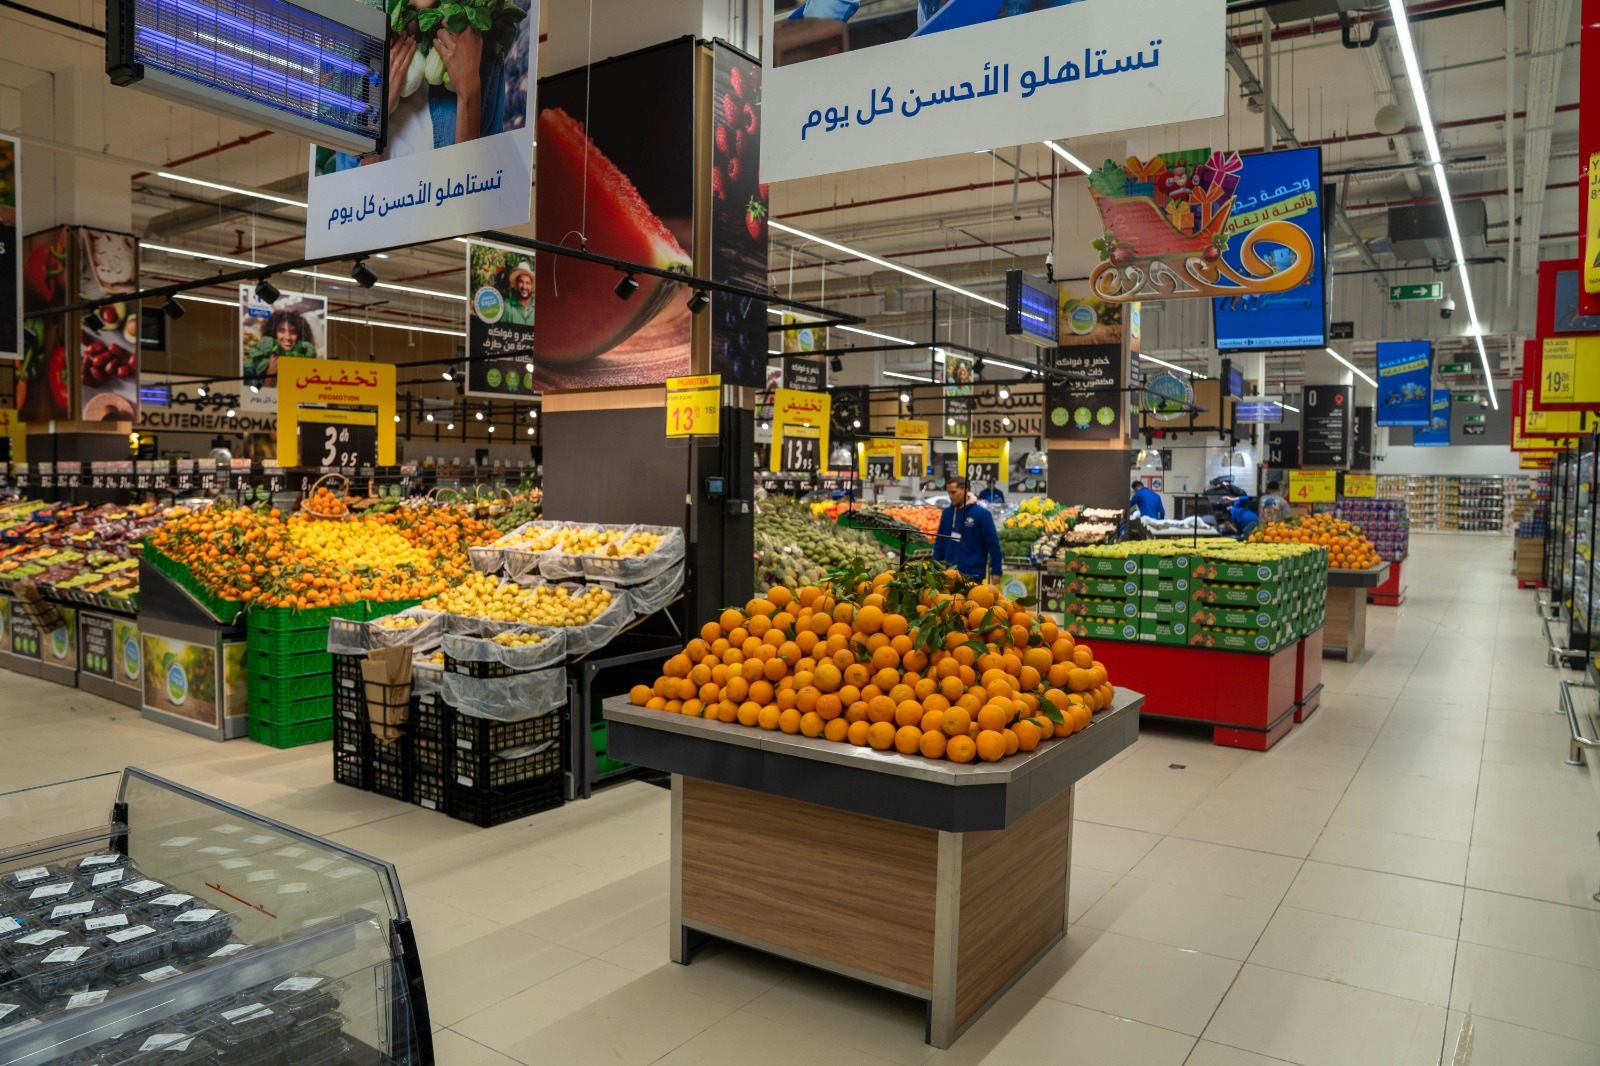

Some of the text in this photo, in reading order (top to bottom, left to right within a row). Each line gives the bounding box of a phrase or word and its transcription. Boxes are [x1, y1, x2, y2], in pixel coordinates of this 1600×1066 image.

[801, 38, 1163, 140] تستاهلو الأحسن كل يوم
[328, 170, 503, 230] تستاهلو الأحسن كل يوم
[296, 368, 378, 390] تخفيض
[1546, 371, 1561, 392] 19
[318, 394, 360, 402] PROMOTION
[783, 397, 822, 414] تخفيض
[672, 406, 694, 432] 13
[322, 426, 338, 466] 3
[340, 452, 358, 466] 95
[788, 439, 803, 470] 13
